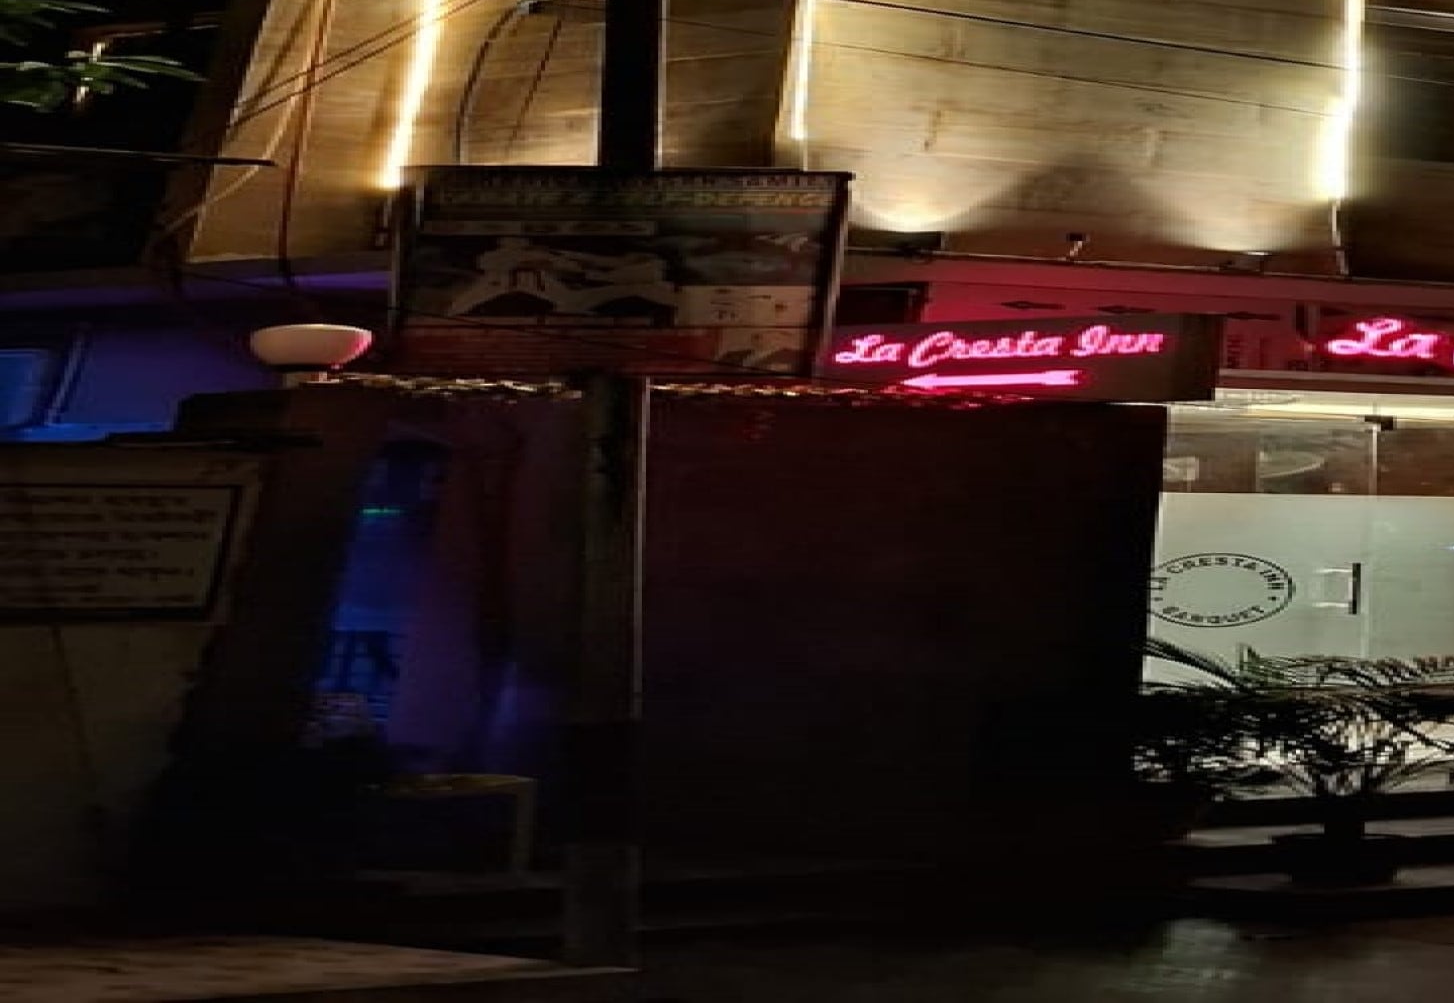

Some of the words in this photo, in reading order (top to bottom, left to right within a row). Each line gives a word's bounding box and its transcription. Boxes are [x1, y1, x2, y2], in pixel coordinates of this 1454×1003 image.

[834, 333, 905, 364] La
[907, 330, 1064, 368] Cresta
[1069, 324, 1165, 357] Inn
[1326, 317, 1440, 359] La
